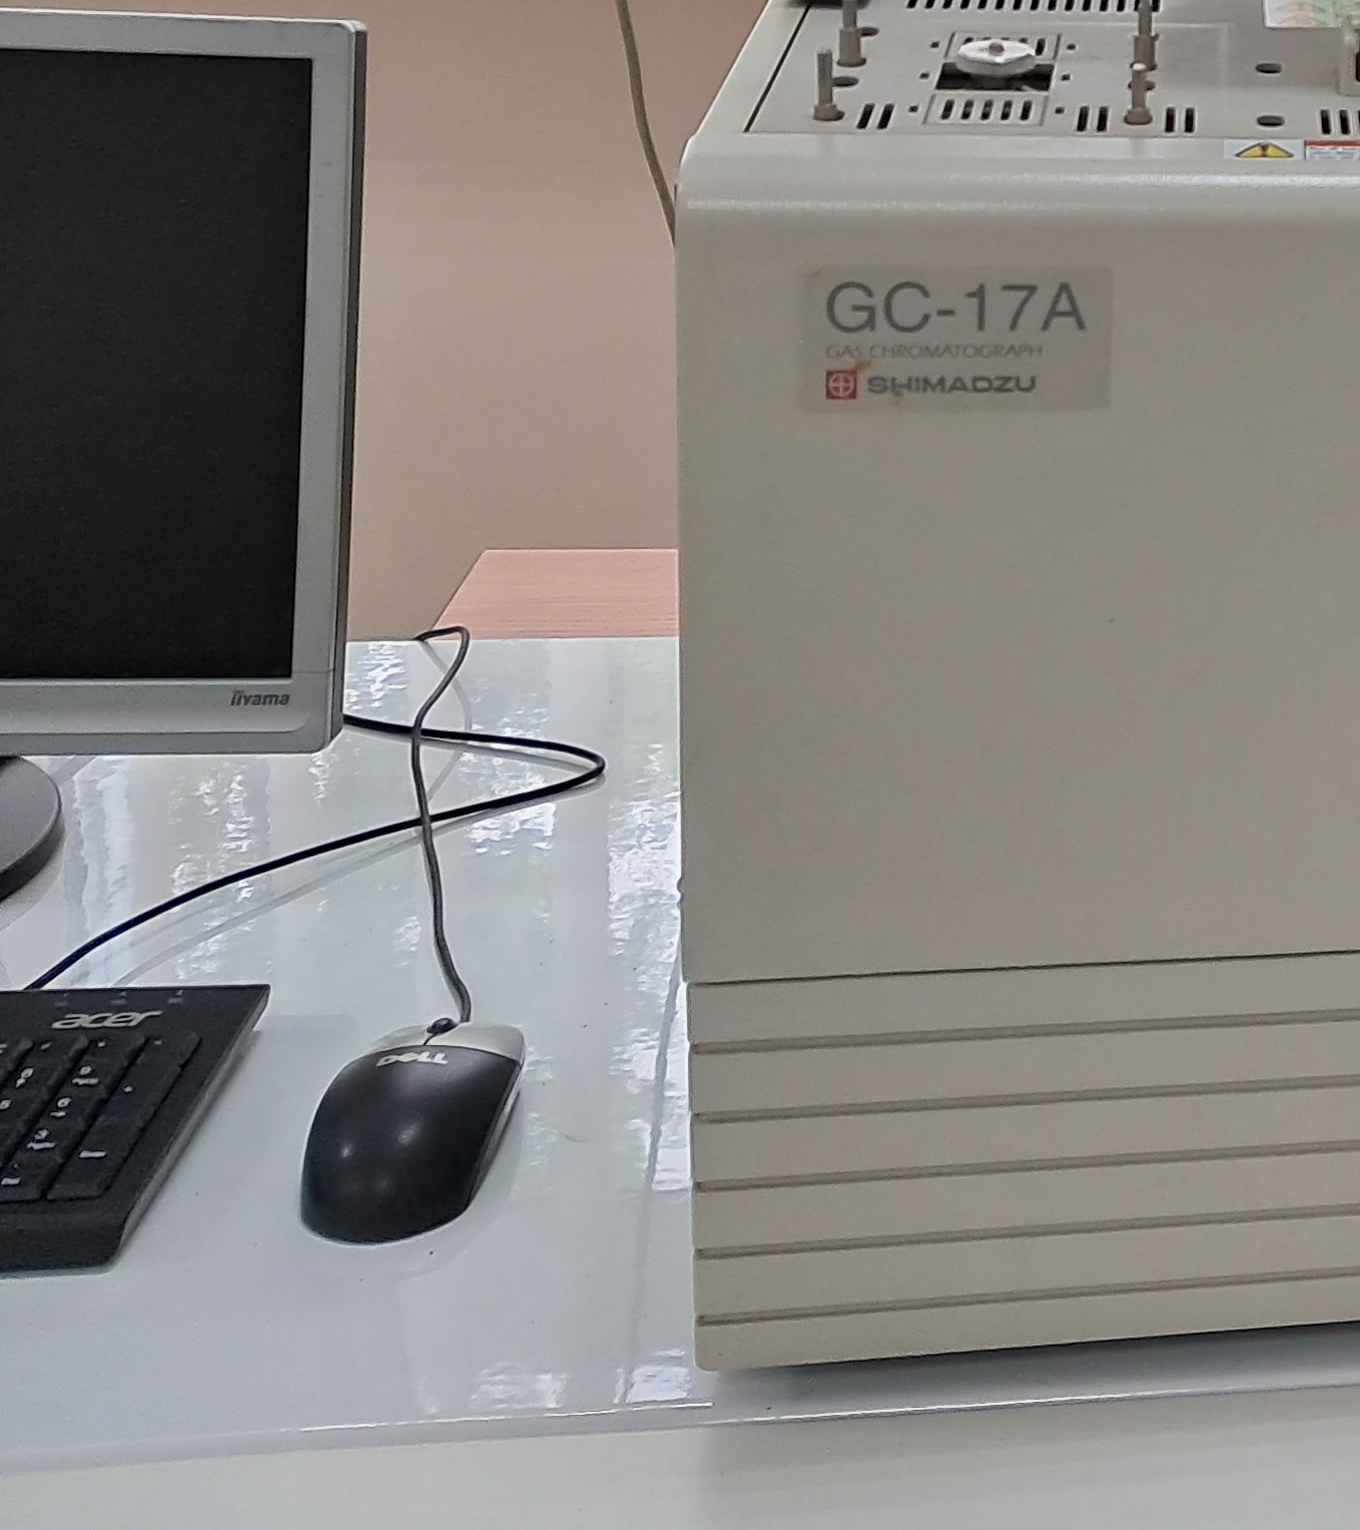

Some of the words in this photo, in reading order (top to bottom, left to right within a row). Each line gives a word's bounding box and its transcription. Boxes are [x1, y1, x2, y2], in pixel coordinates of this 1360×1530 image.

[825, 281, 1087, 334] GC-17A
[825, 343, 863, 359] GAS
[869, 343, 1044, 360] CHROMATOGRAPH
[866, 375, 1037, 395] SHIMADZU
[230, 689, 291, 707] iiyama
[51, 1009, 165, 1030] acer
[377, 1050, 449, 1067] DELL
